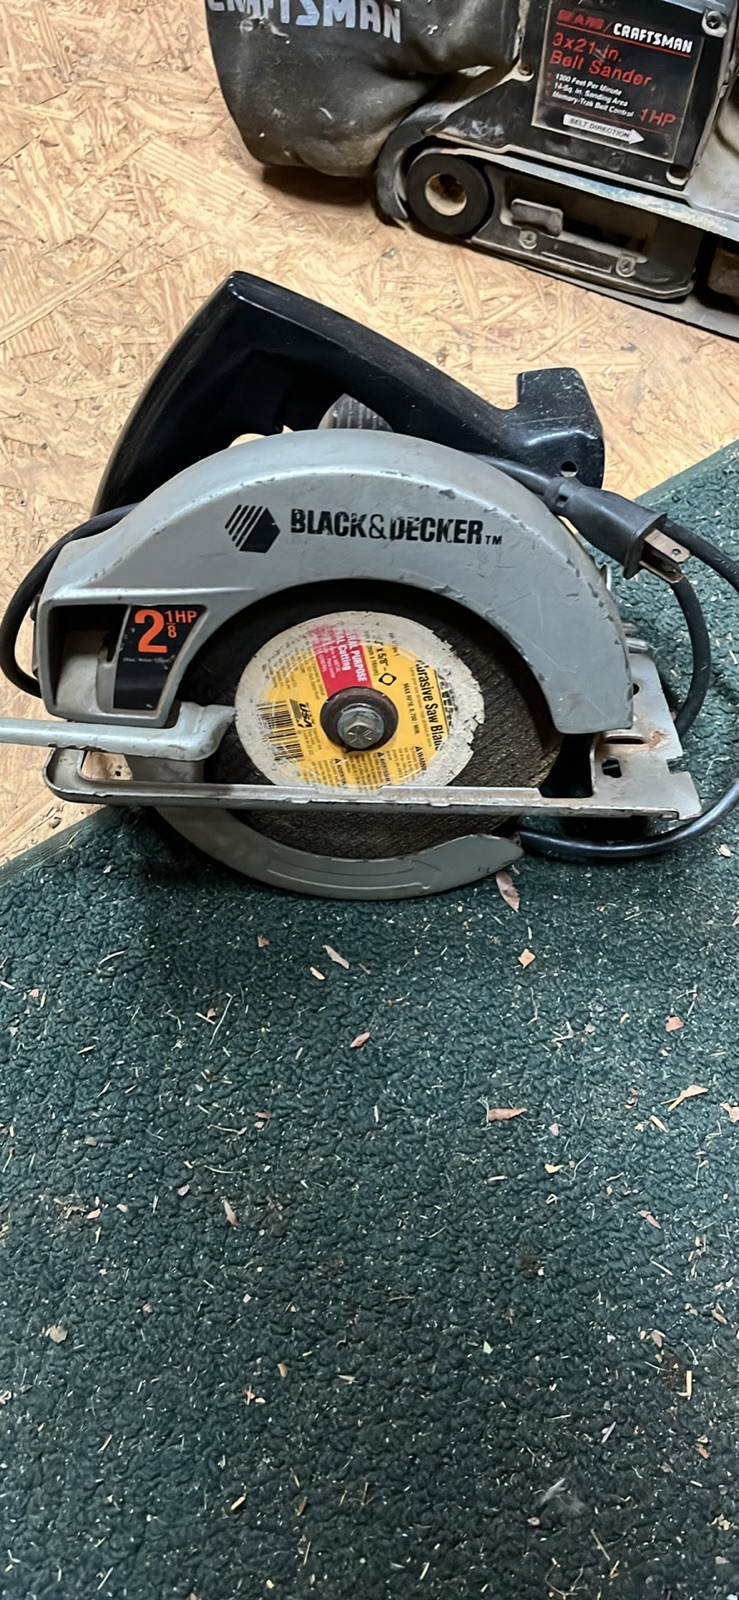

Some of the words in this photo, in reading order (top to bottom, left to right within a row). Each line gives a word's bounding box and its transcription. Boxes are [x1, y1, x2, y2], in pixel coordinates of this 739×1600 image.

[613, 22, 694, 54] CRAFTSMAN
[550, 49, 585, 69] Belt
[588, 59, 652, 86] Sander
[571, 77, 586, 86] Feet
[586, 81, 599, 90] Per
[599, 84, 622, 96] Minute
[584, 90, 612, 104] Sanding
[612, 97, 628, 107] Area
[595, 102, 609, 112] Belt
[609, 106, 635, 118] Control
[649, 110, 677, 127] HP
[570, 118, 588, 129] BELT
[589, 122, 630, 138] DIRECTION
[290, 508, 484, 545] BLACK&DECKER
[134, 609, 167, 653] 2
[338, 645, 351, 671] Cutting
[350, 650, 368, 682] PURPOSE
[299, 702, 313, 728] USA
[425, 703, 439, 724] Saw
